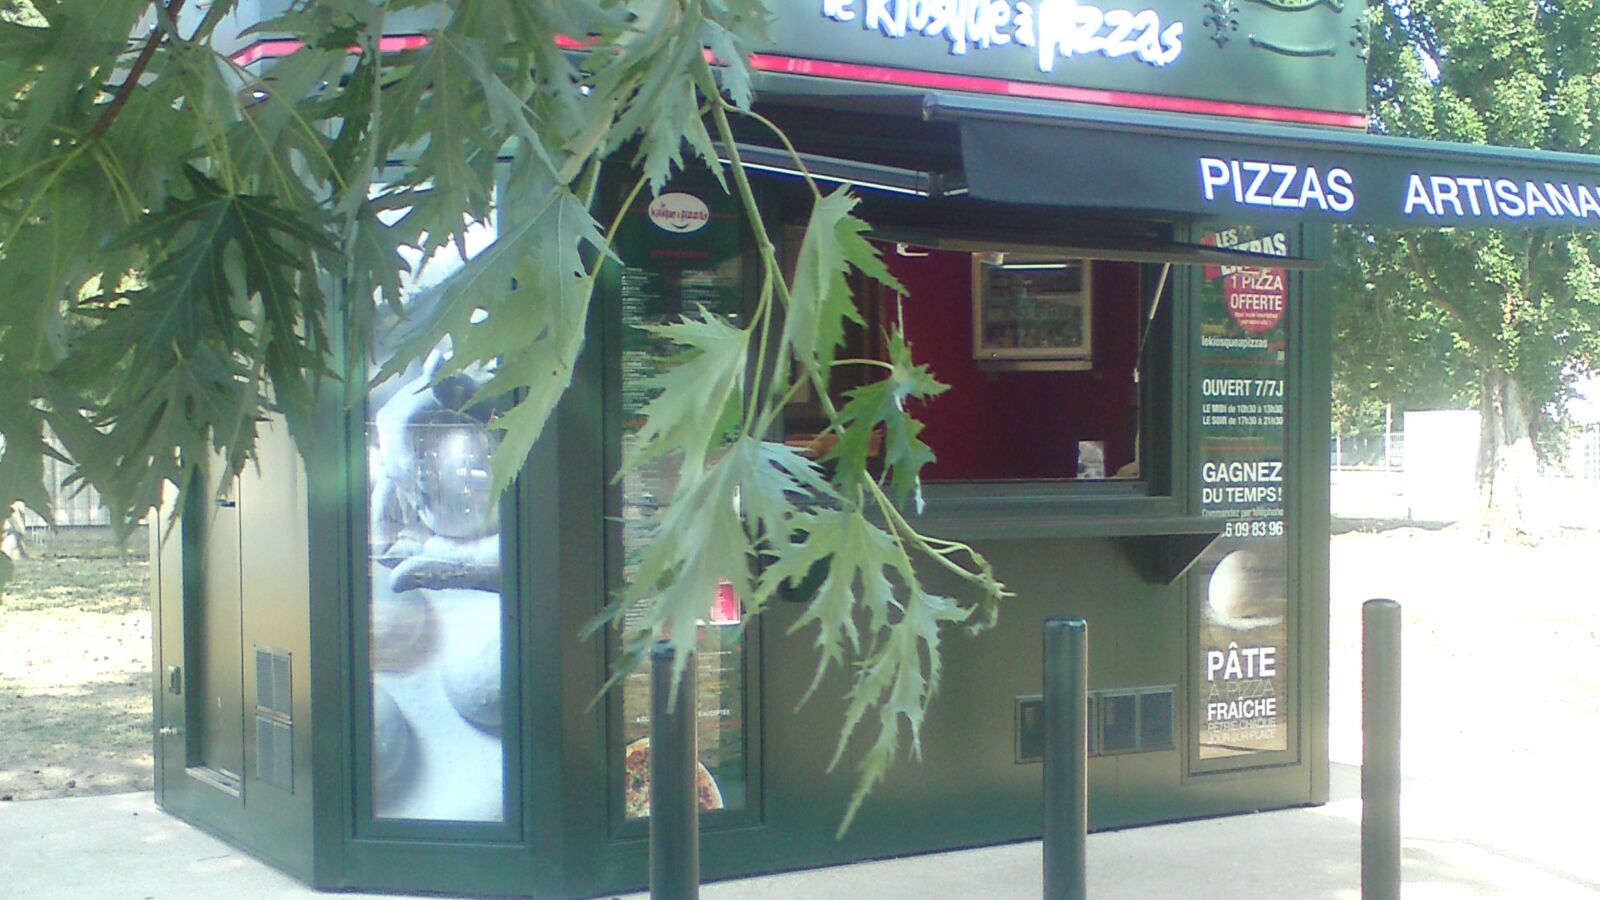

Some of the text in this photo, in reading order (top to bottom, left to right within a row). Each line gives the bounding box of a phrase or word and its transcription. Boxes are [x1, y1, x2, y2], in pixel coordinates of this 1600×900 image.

[1038, 0, 1184, 72] pizzas
[1200, 157, 1600, 218] PIZZAS ARTISANA
[1216, 229, 1238, 248] LES
[1231, 274, 1284, 291] 1 PIZZA
[1230, 293, 1283, 311] OFFERTE
[1202, 379, 1284, 397] OUVERT 7/7J
[1202, 404, 1211, 413] LE
[1202, 416, 1211, 425] LE
[1202, 462, 1283, 482] GAGNEZ
[1202, 488, 1223, 503] DU
[1235, 522, 1249, 537] 09
[1251, 521, 1266, 537] 83
[1269, 520, 1284, 536] 96
[1207, 641, 1276, 681] PÂTE
[1225, 678, 1275, 700] PIZZA
[1207, 696, 1276, 721] FRAÎCHE
